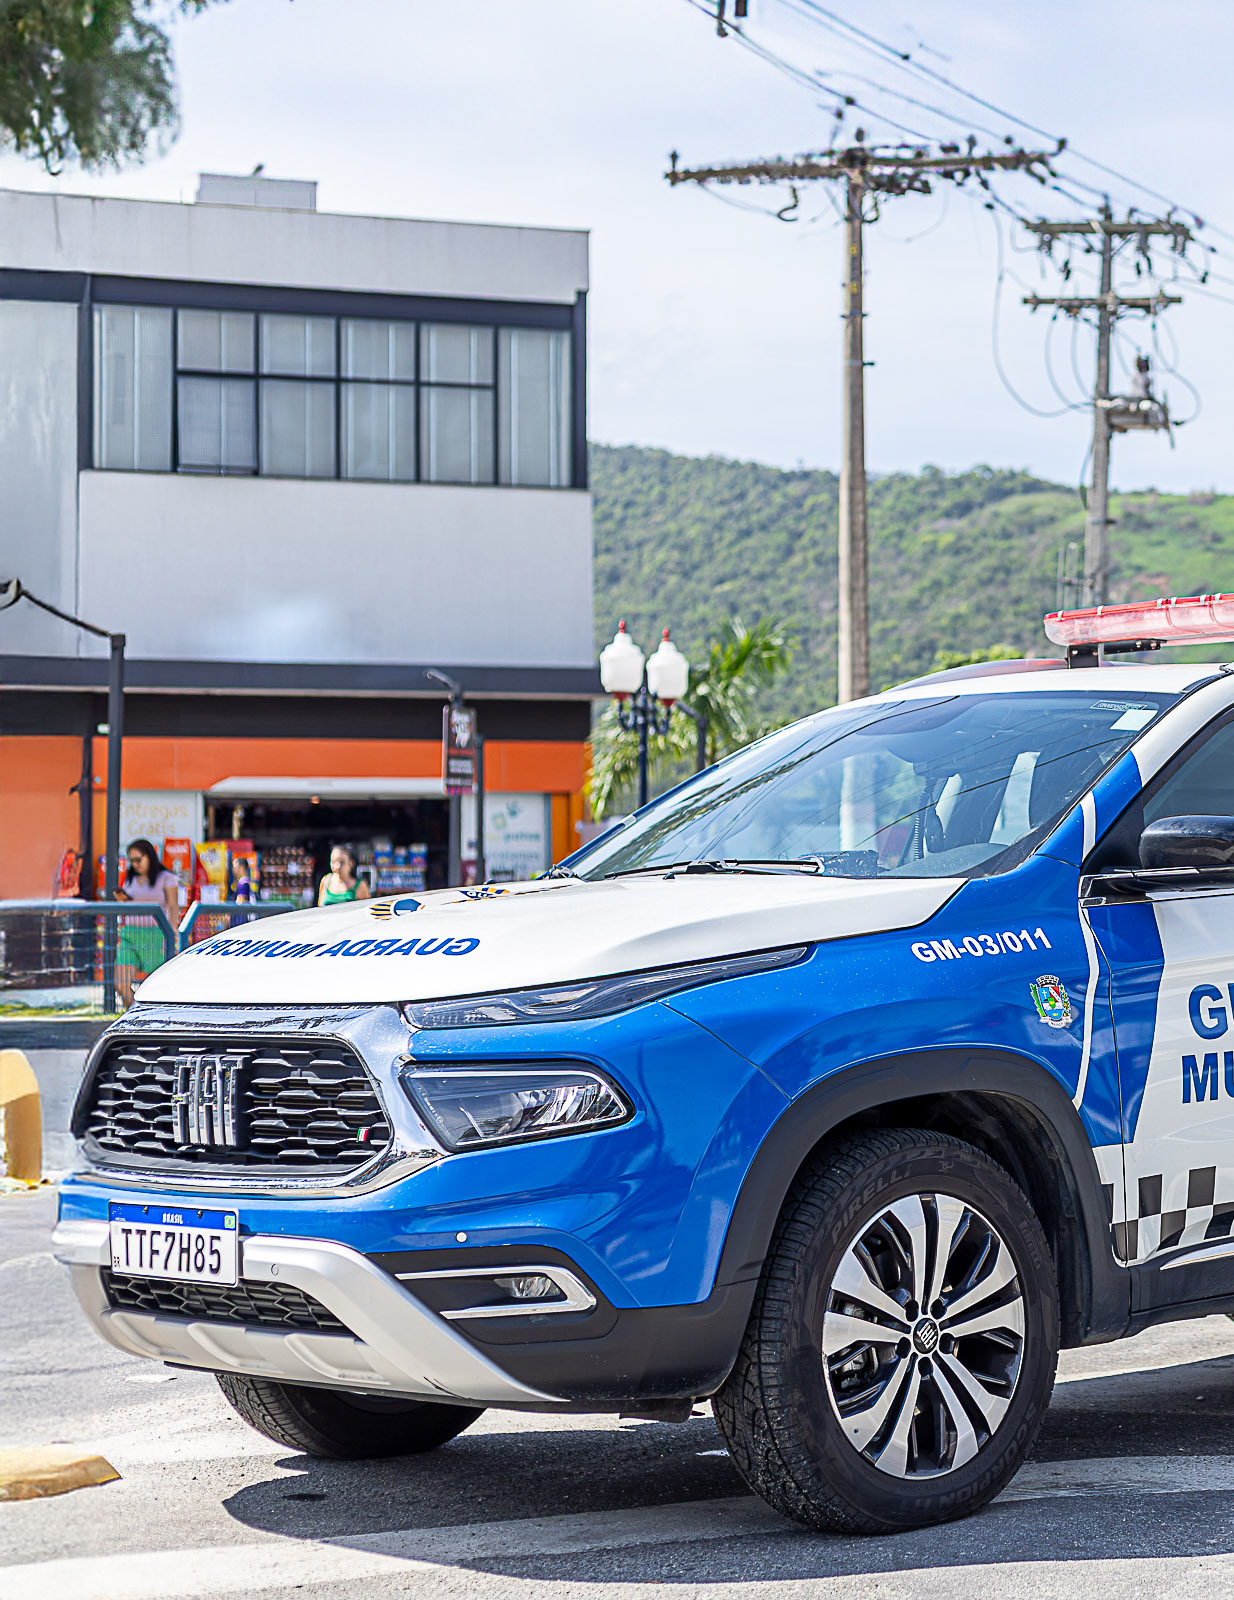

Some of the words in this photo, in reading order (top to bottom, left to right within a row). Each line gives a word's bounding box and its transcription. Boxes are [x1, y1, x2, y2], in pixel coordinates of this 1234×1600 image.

[911, 928, 1052, 962] GM-03/011
[162, 1213, 184, 1225] BRASIL
[832, 1163, 912, 1245] PIRELLI
[121, 1228, 221, 1275] TTF7H85
